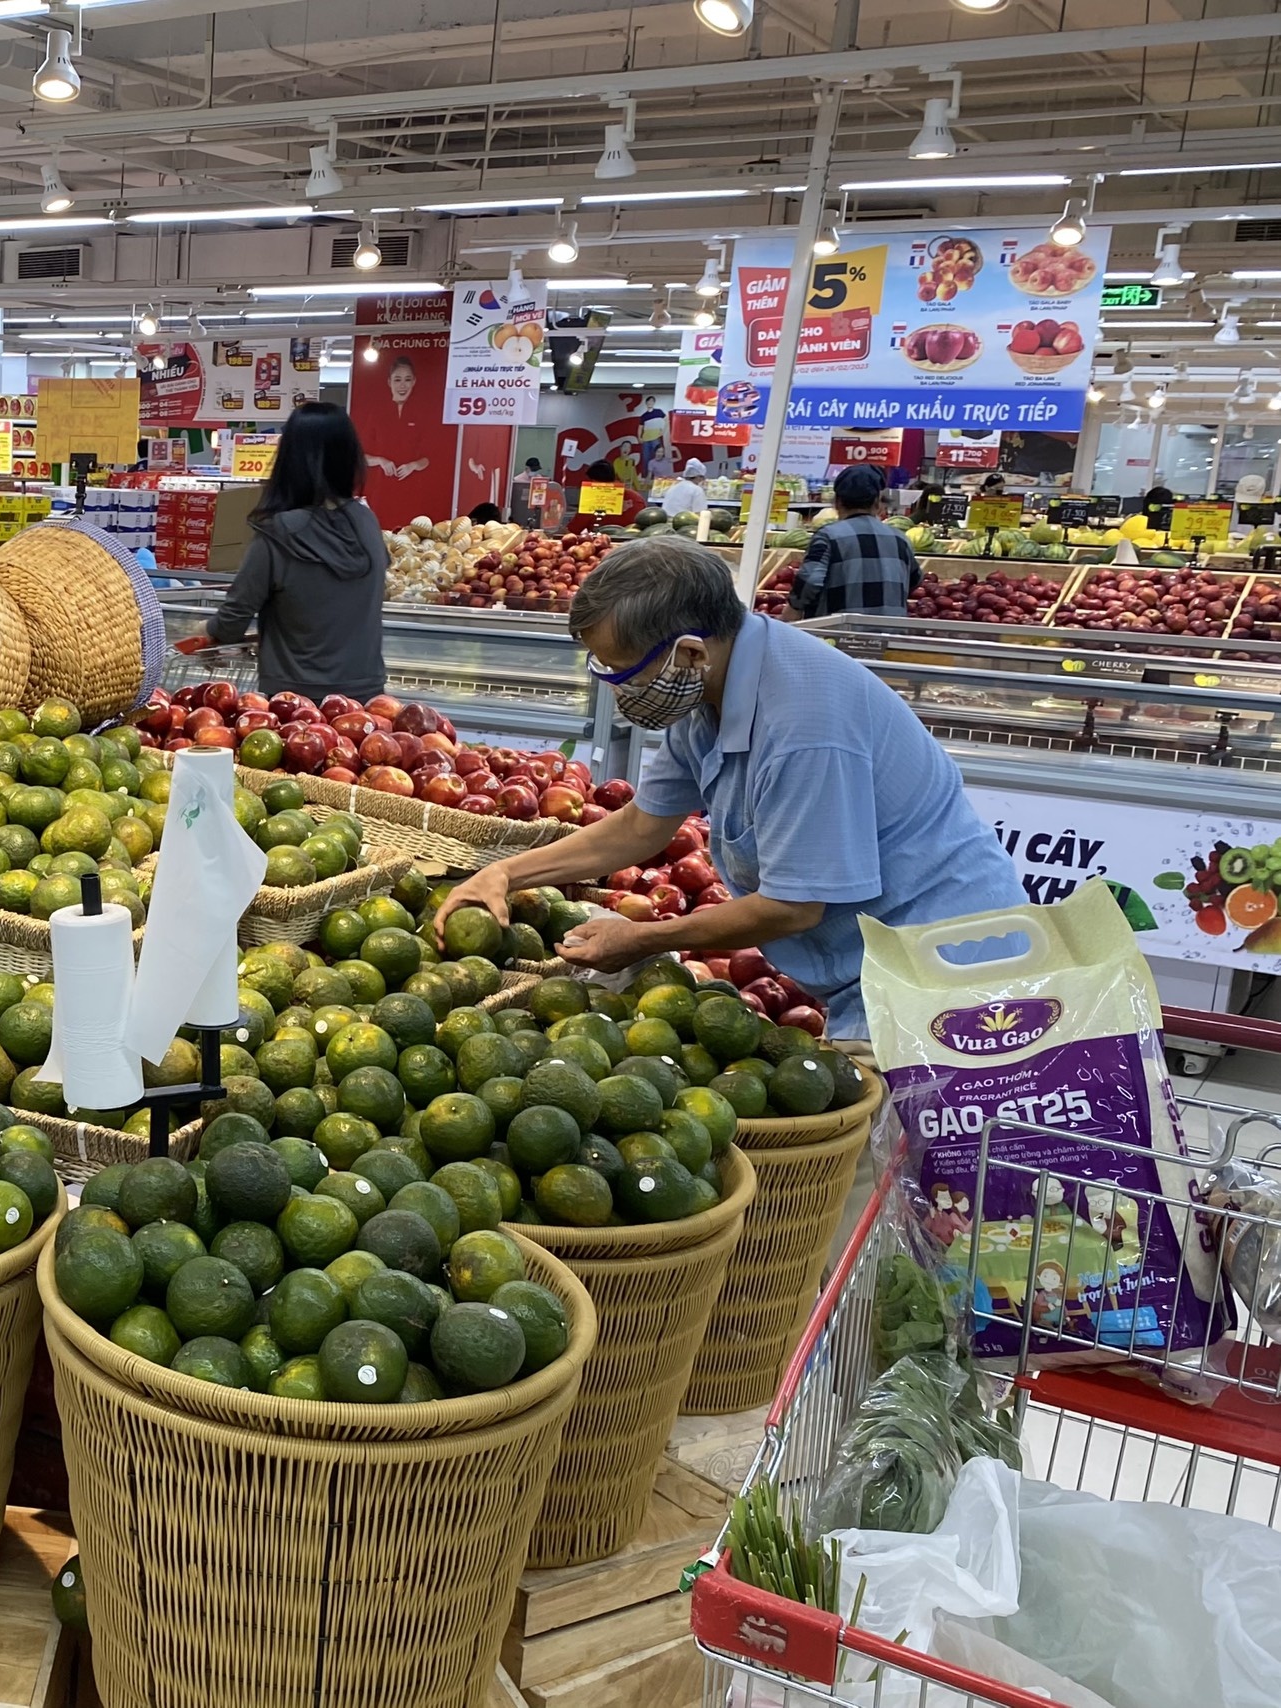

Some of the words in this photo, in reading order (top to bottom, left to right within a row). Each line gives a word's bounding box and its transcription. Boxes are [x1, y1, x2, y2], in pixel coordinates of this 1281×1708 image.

[746, 274, 788, 295] GIẢM
[747, 296, 779, 311] THÊM
[393, 336, 430, 349] CHÚNG
[830, 338, 861, 352] VIÊN
[455, 376, 468, 388] LÊ
[471, 376, 495, 388] HÀN
[498, 375, 531, 390] QUỐC
[818, 397, 848, 419] CÂY
[853, 399, 900, 423] NHẬP
[906, 394, 956, 421] KHẨU
[963, 402, 1011, 426] TRỰC
[239, 460, 263, 471] 220
[1091, 659, 1132, 669] CHERRY
[951, 1030, 998, 1051] Vua
[1001, 1025, 1044, 1049] Gạo
[962, 1078, 994, 1091] GẠO
[997, 1069, 1033, 1086] THƠM
[959, 1090, 1012, 1102] FRAGRANT
[1013, 1081, 1038, 1094] RICE
[919, 1105, 984, 1142] GẠO
[996, 1089, 1093, 1131] ST25
[983, 1343, 989, 1351] 5
[992, 1342, 1004, 1353] kg
